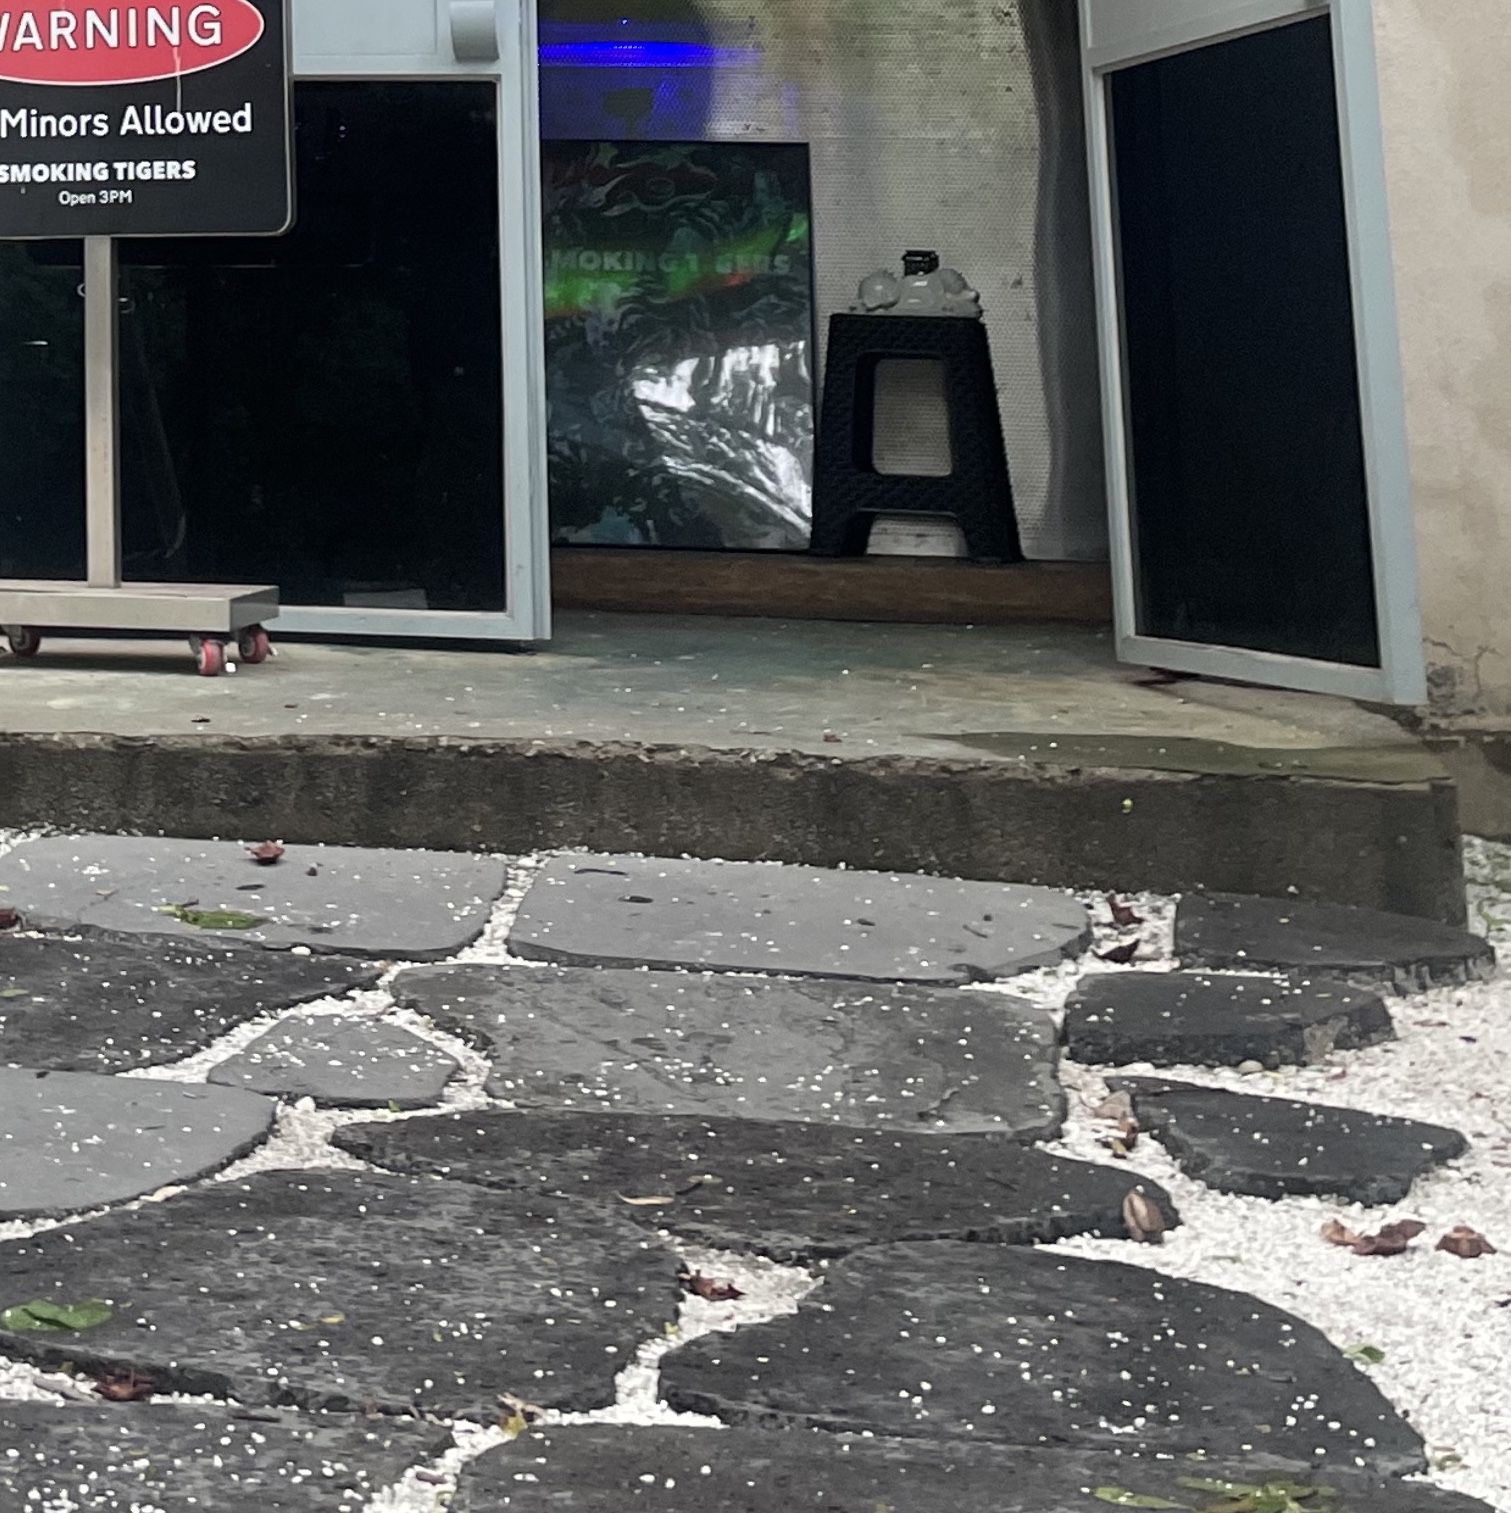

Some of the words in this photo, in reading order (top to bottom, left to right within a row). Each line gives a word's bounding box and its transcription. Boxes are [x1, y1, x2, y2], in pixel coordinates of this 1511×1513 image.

[0, 107, 110, 138] Minors
[119, 102, 253, 137] Allowed
[113, 159, 196, 182] TIGERS
[58, 190, 96, 207] Open
[99, 189, 133, 205] 3PM
